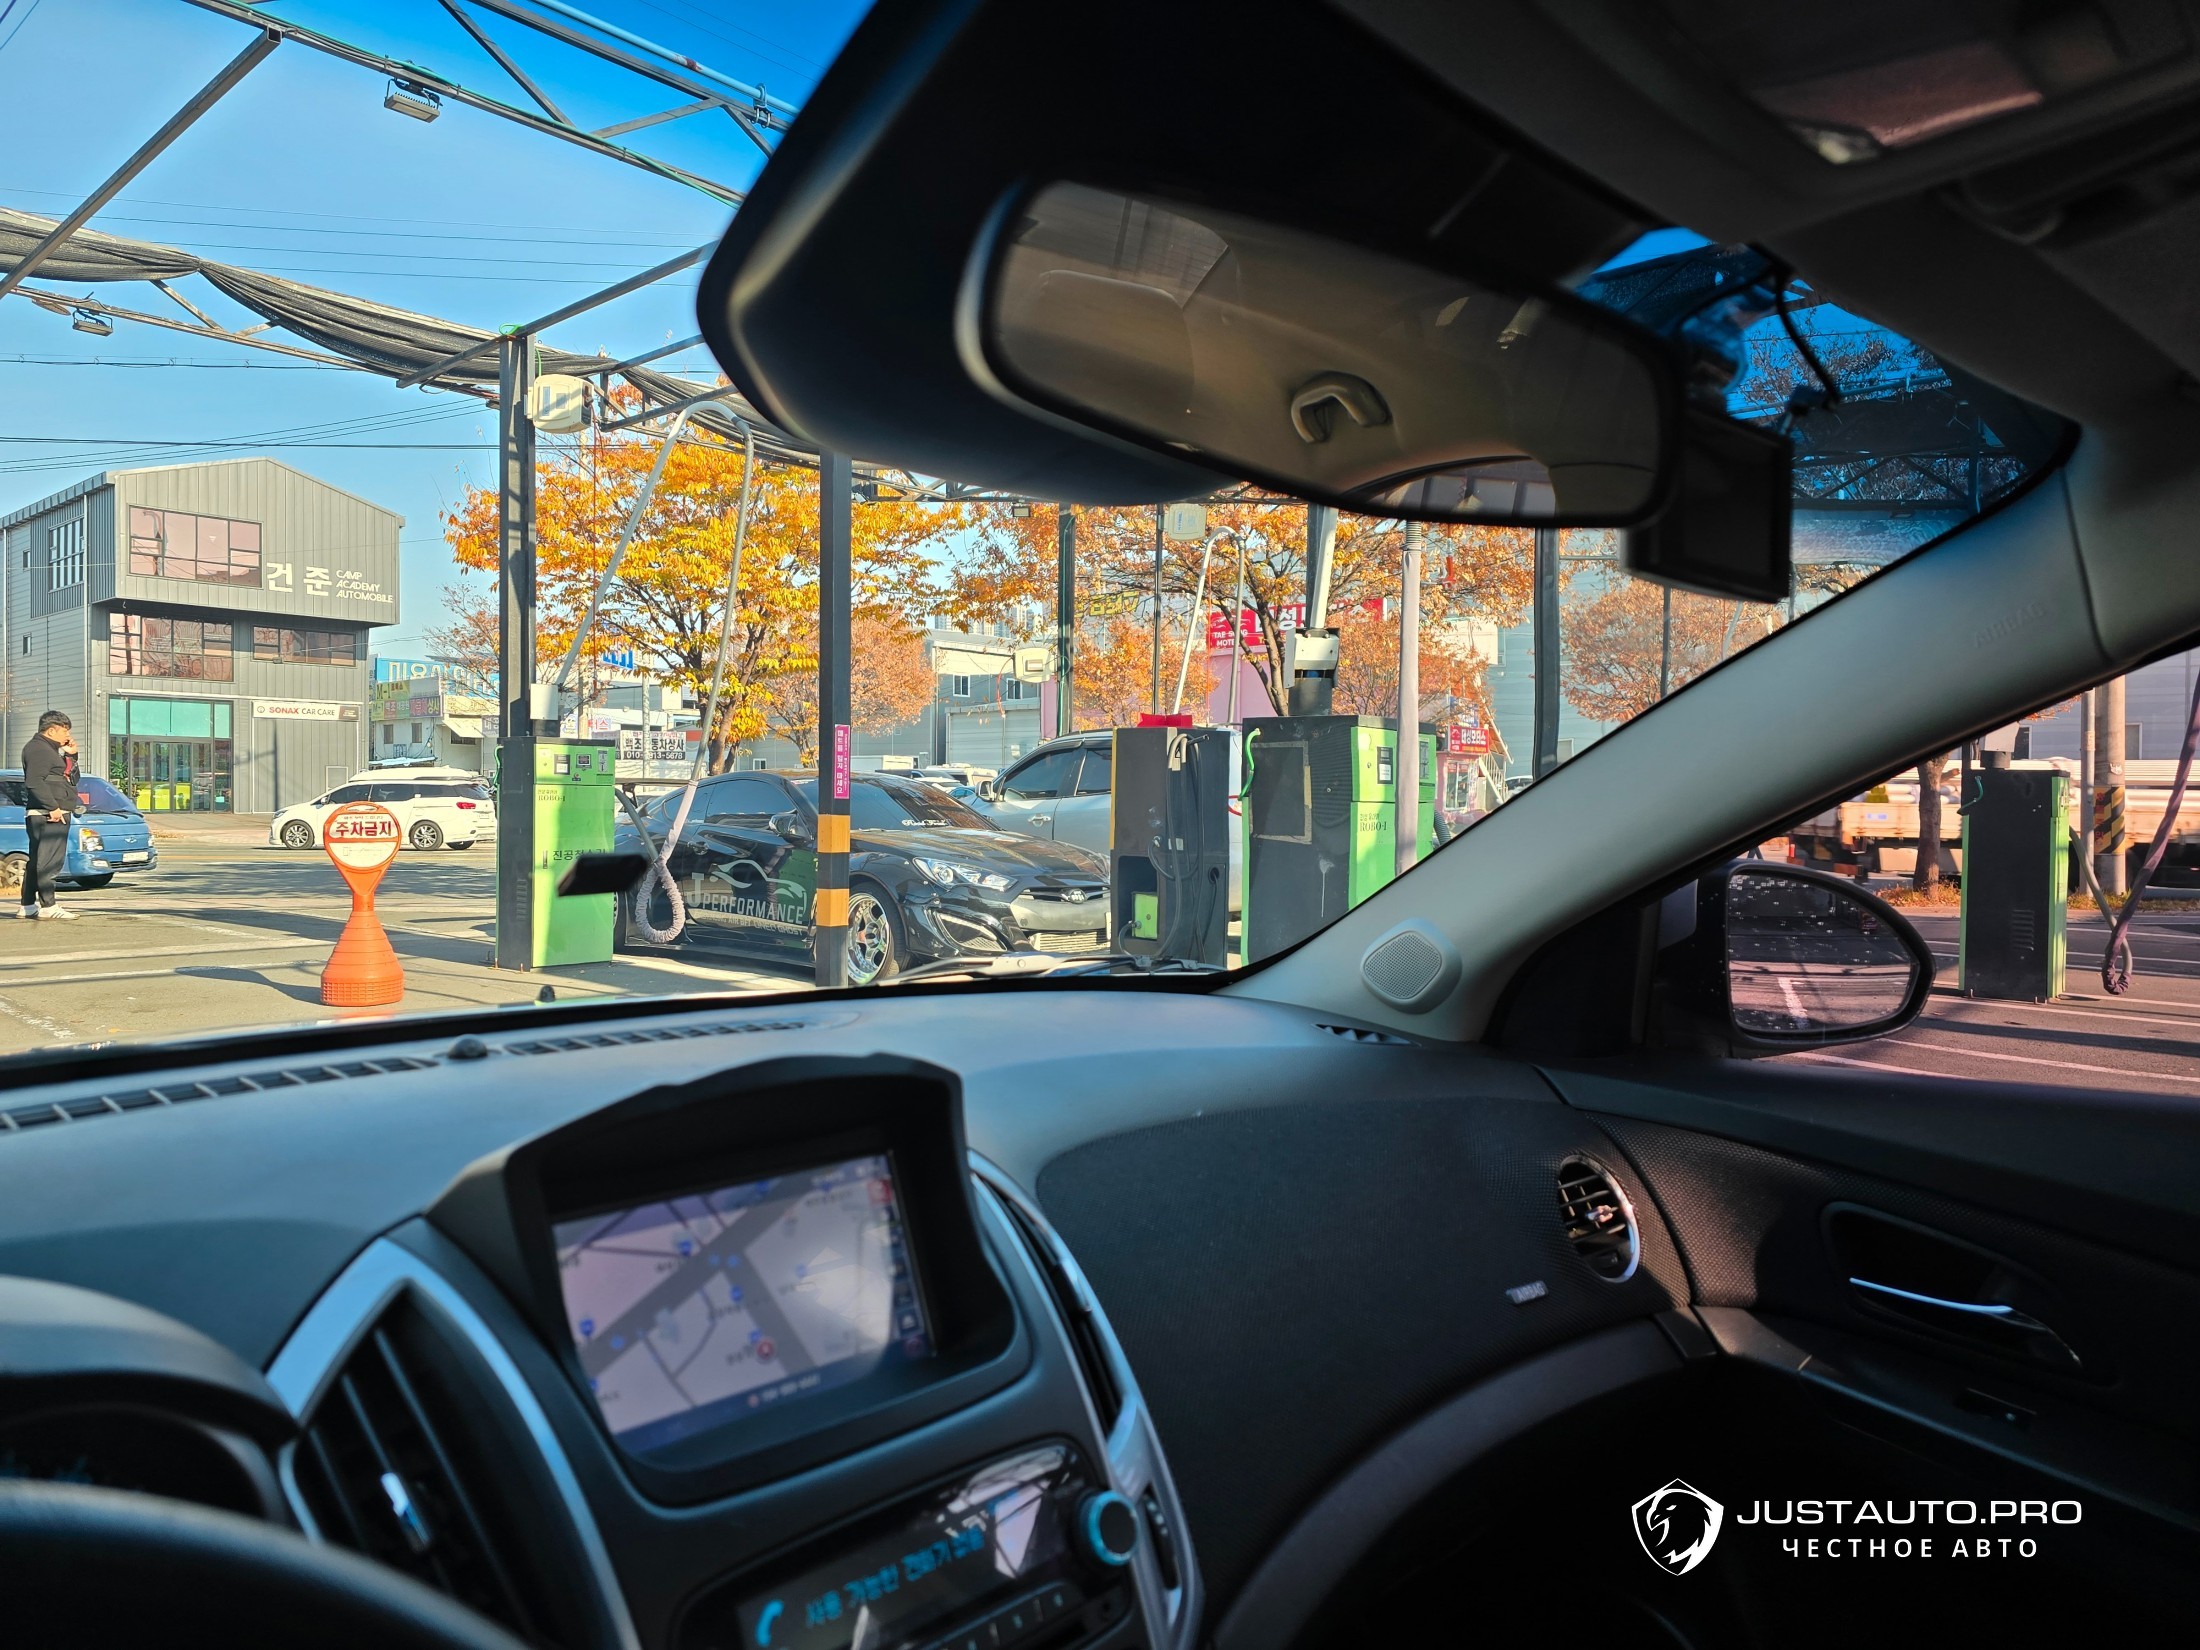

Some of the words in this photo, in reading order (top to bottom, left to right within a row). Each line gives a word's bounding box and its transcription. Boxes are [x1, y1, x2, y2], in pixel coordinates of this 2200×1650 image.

[336, 570, 363, 580] CAMP
[336, 580, 381, 593] ACADEMY
[336, 589, 394, 604] AUTOMOBILE
[268, 706, 299, 715] SONAX
[301, 707, 316, 716] CAR
[317, 708, 336, 716] CARE
[625, 737, 685, 751] 백조동차상사
[335, 820, 392, 837] 주차금지
[553, 848, 607, 861] 진공청
[702, 893, 804, 925] PERFORMANCE
